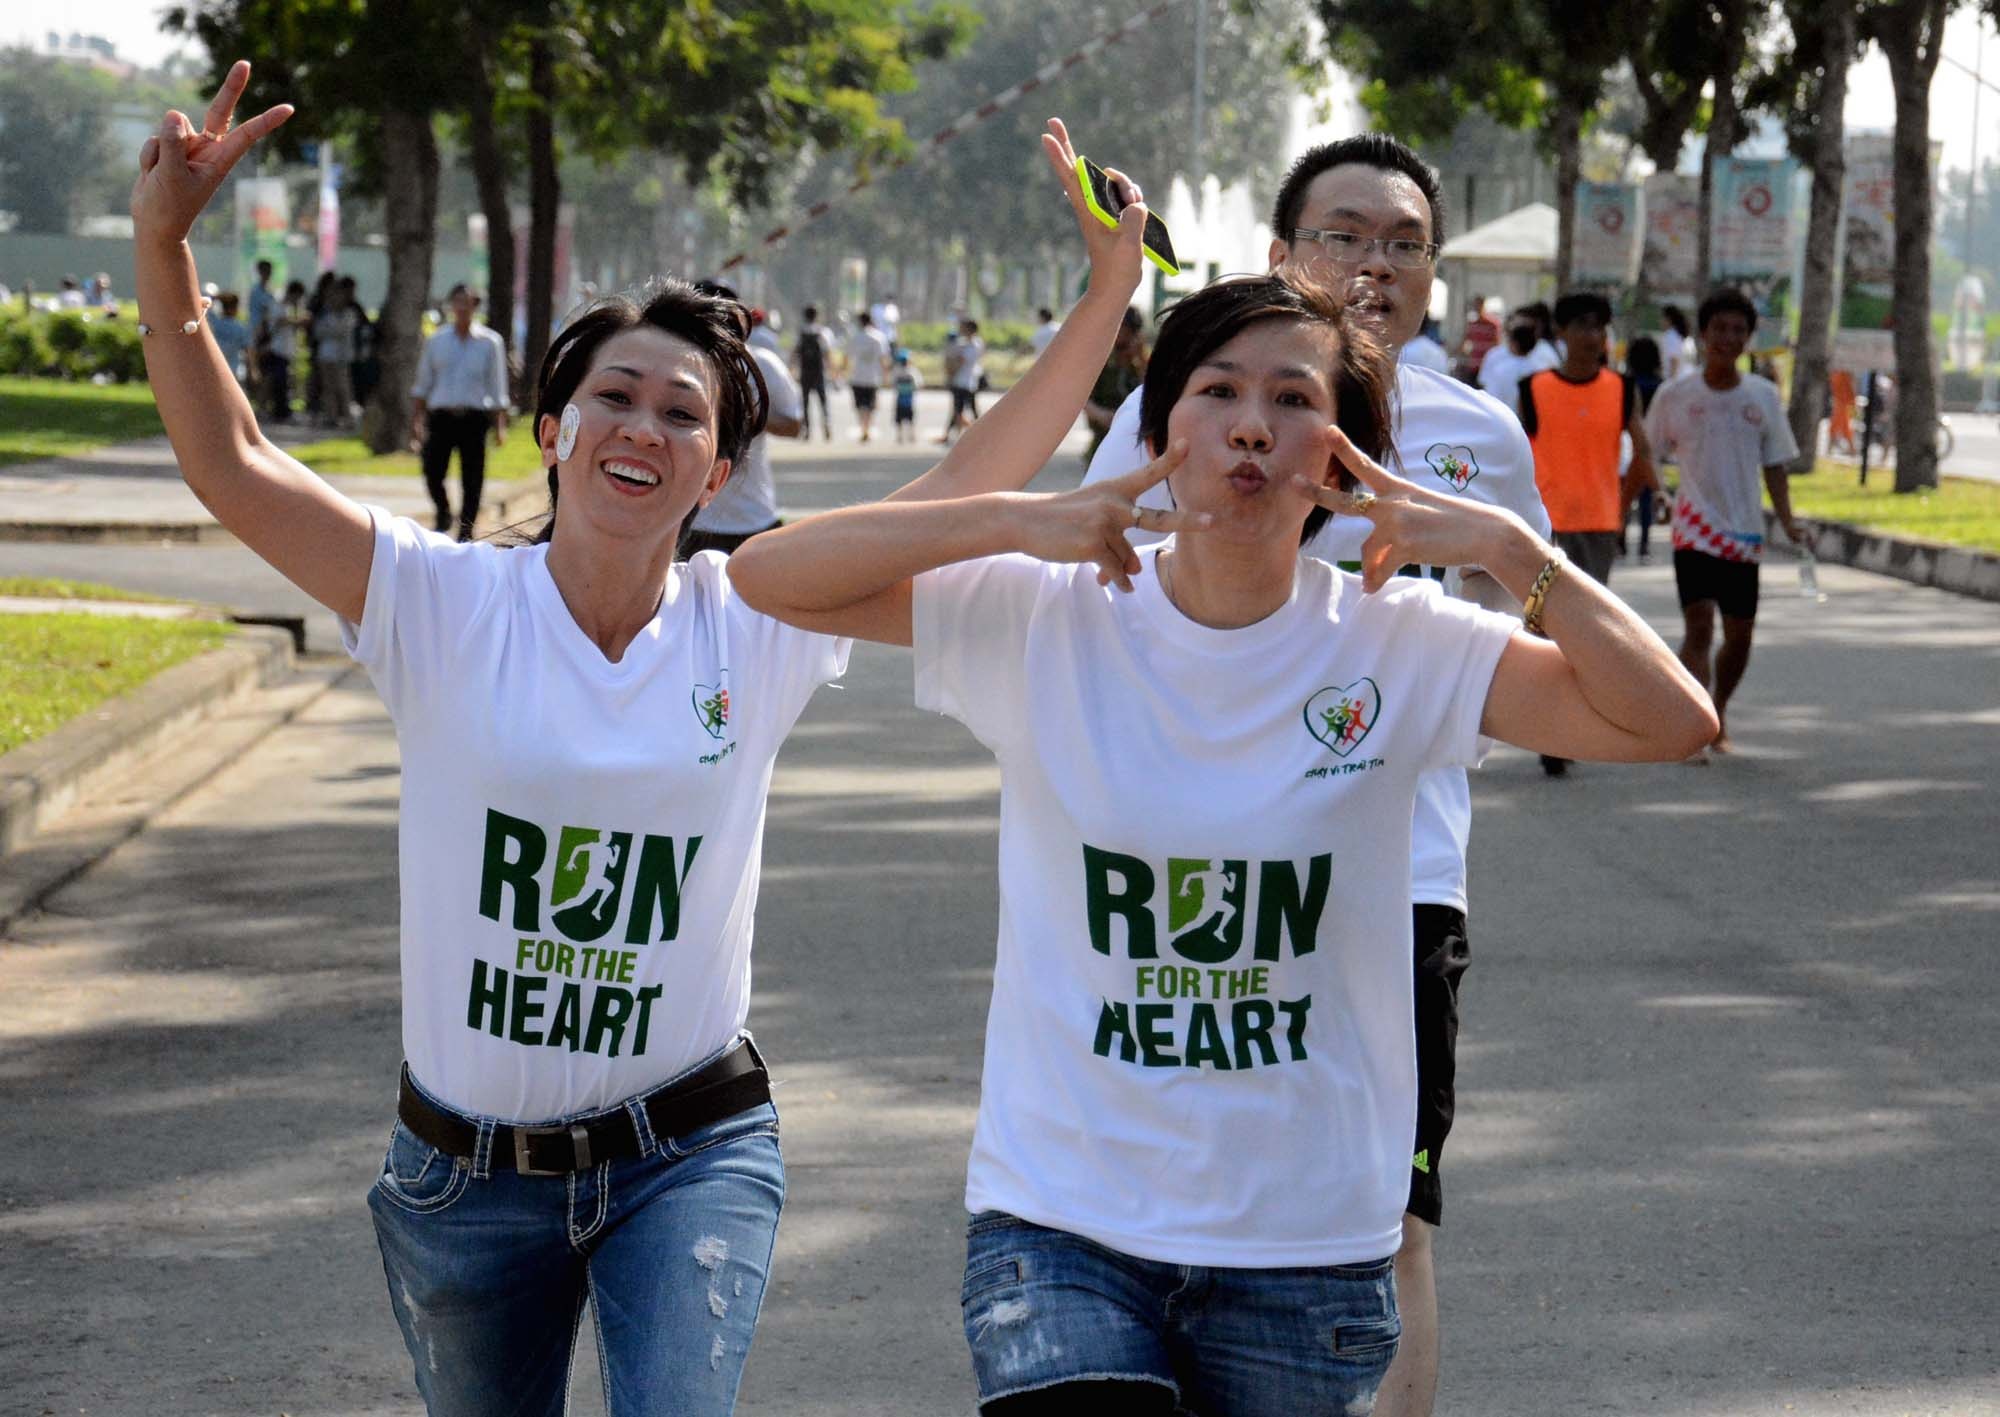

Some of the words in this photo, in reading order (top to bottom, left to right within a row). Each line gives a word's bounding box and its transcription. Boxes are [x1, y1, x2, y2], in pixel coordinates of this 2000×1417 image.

[479, 808, 703, 945] RUN
[1083, 843, 1332, 963] RUN
[516, 938, 576, 978] FOR
[580, 948, 637, 983] THE
[1137, 965, 1201, 998] FOR
[1207, 967, 1269, 999] THE
[467, 958, 663, 1058] HEART
[1093, 994, 1311, 1070] HEART
